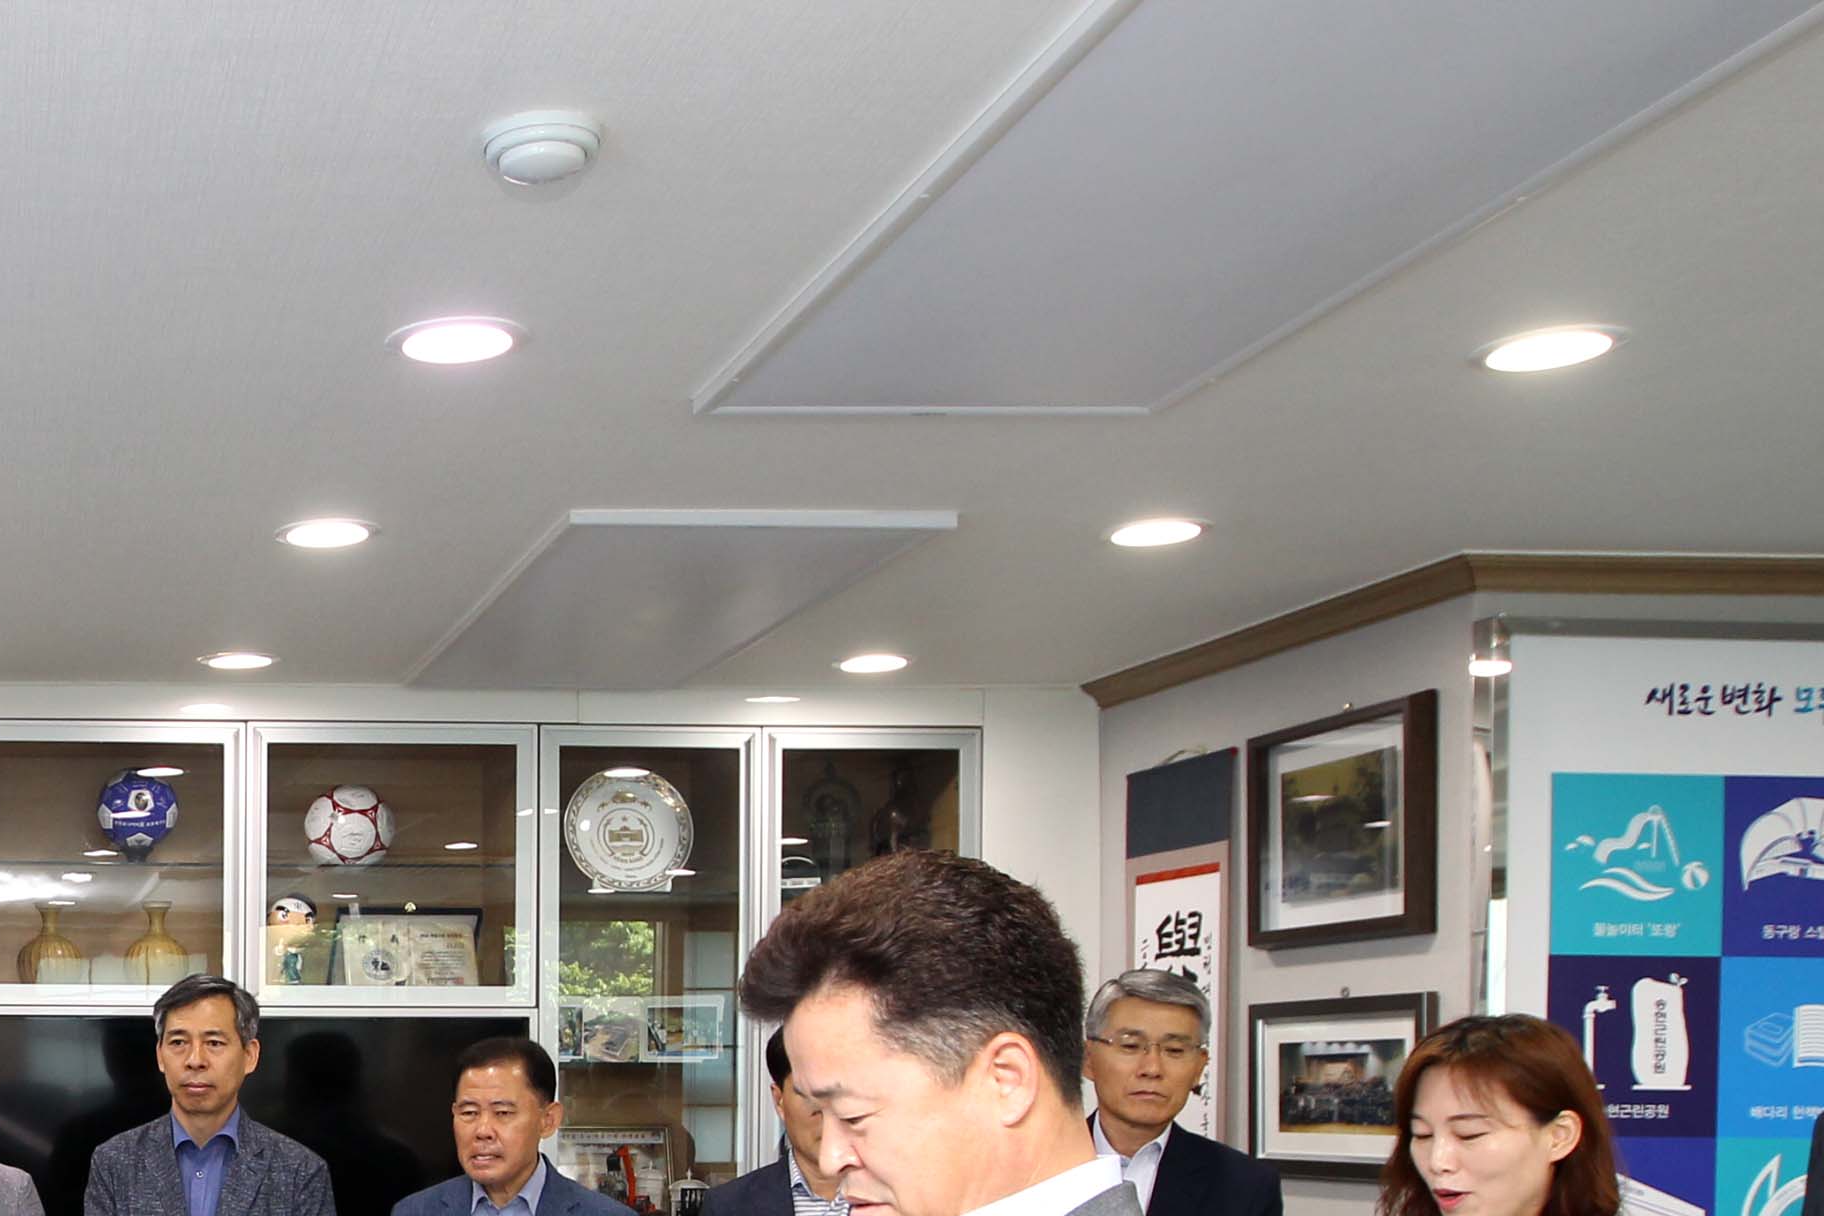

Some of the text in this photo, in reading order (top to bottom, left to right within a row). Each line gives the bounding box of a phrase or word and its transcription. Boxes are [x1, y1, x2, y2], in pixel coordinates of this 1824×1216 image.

[1644, 682, 1824, 725] 새로운 변화 모
[1761, 924, 1801, 940] 동구랑
[1606, 1103, 1670, 1119] 현근린공원
